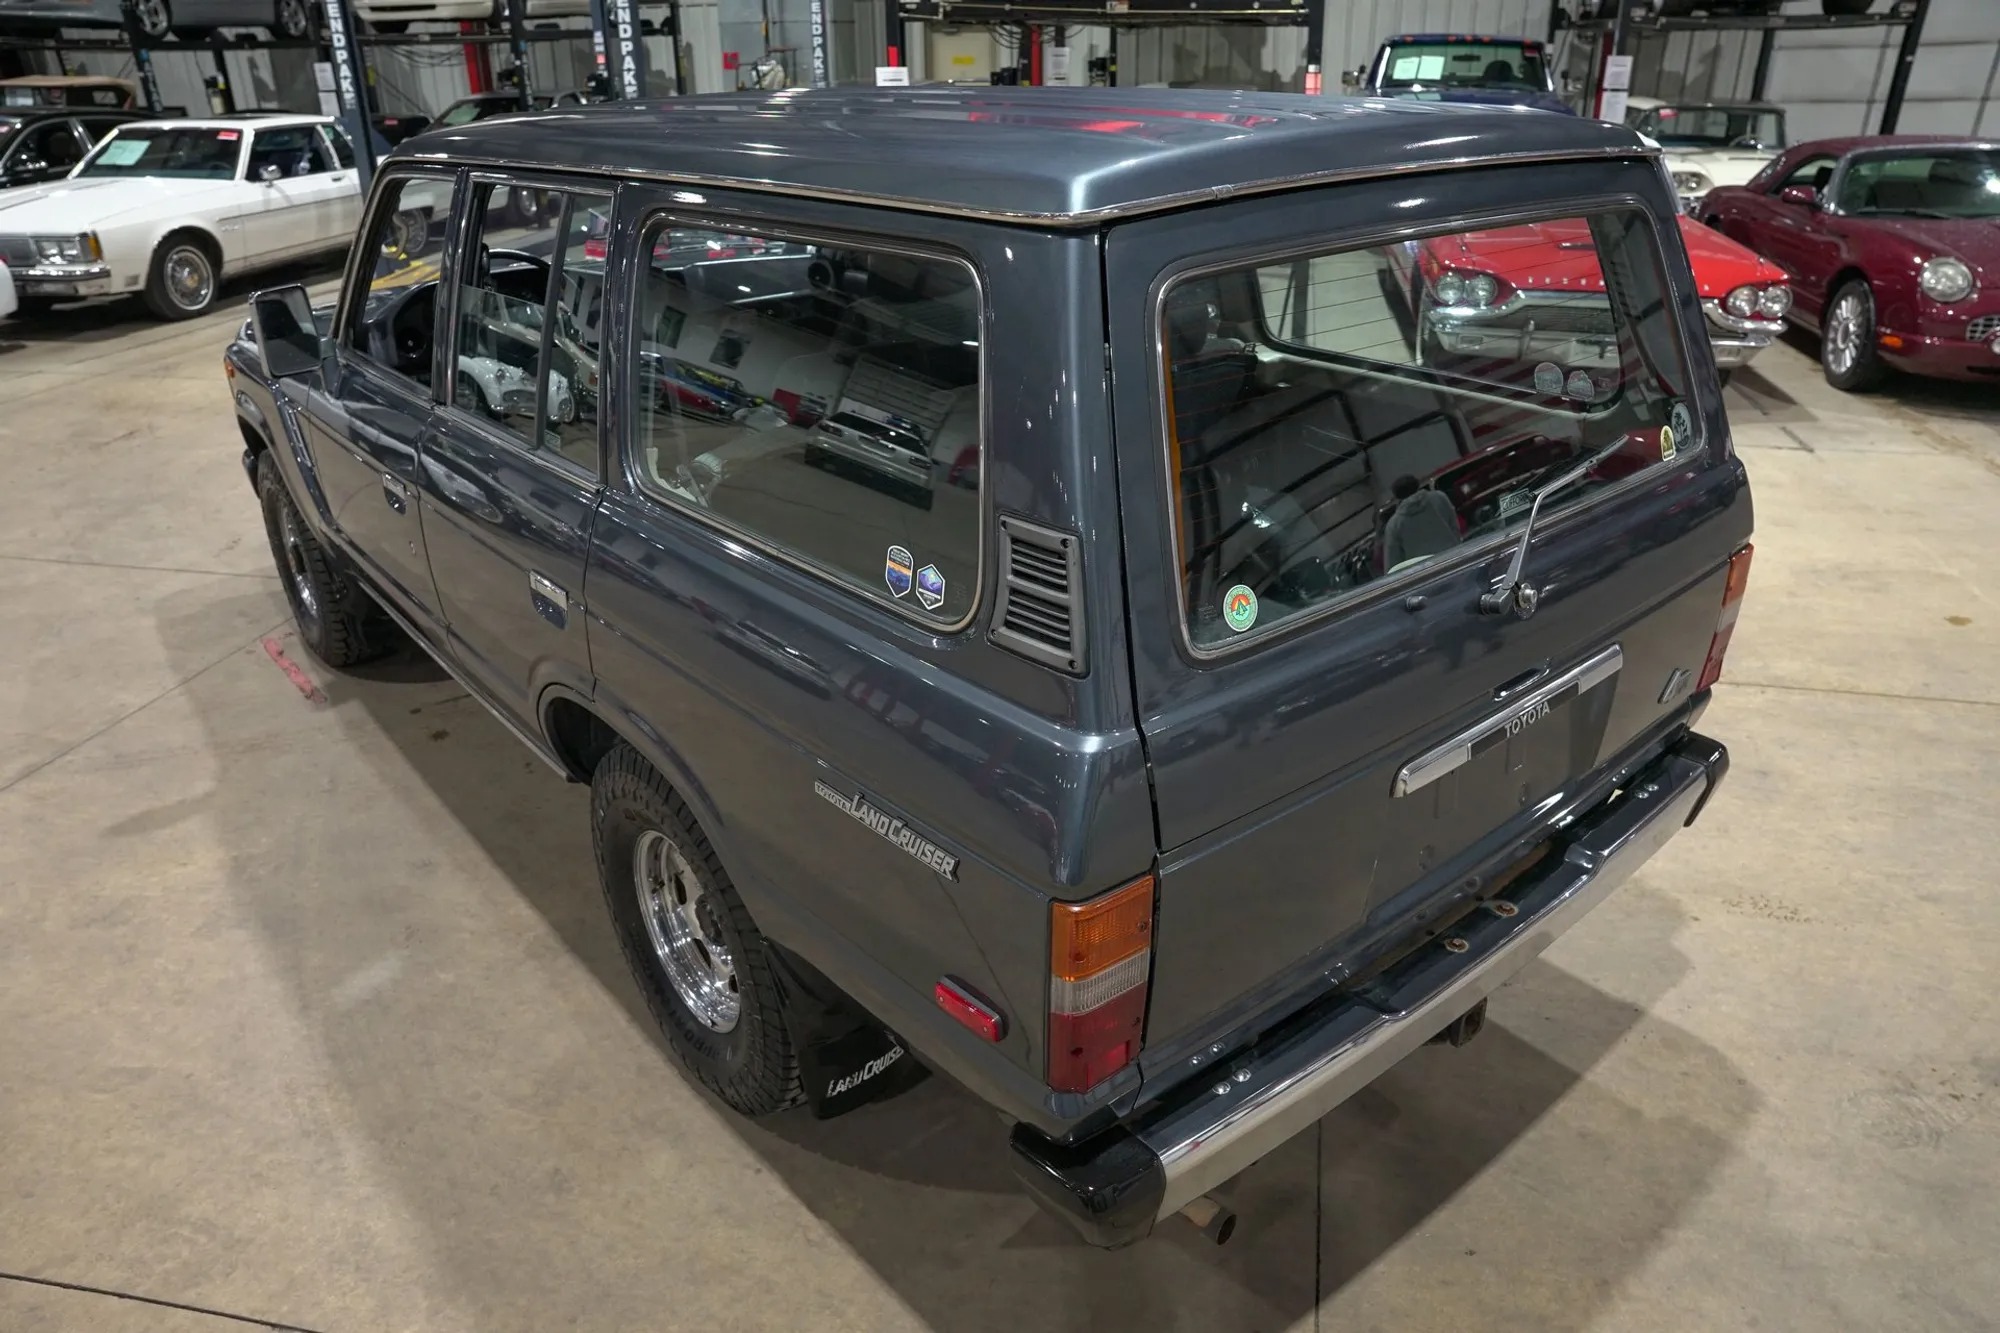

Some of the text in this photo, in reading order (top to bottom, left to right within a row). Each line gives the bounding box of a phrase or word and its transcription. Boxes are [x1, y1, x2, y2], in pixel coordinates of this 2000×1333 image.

[326, 0, 354, 92] ENDPAK
[811, 0, 824, 70] ENDPAK
[1504, 701, 1551, 739] TOYOTA
[888, 818, 955, 881] CRUISER
